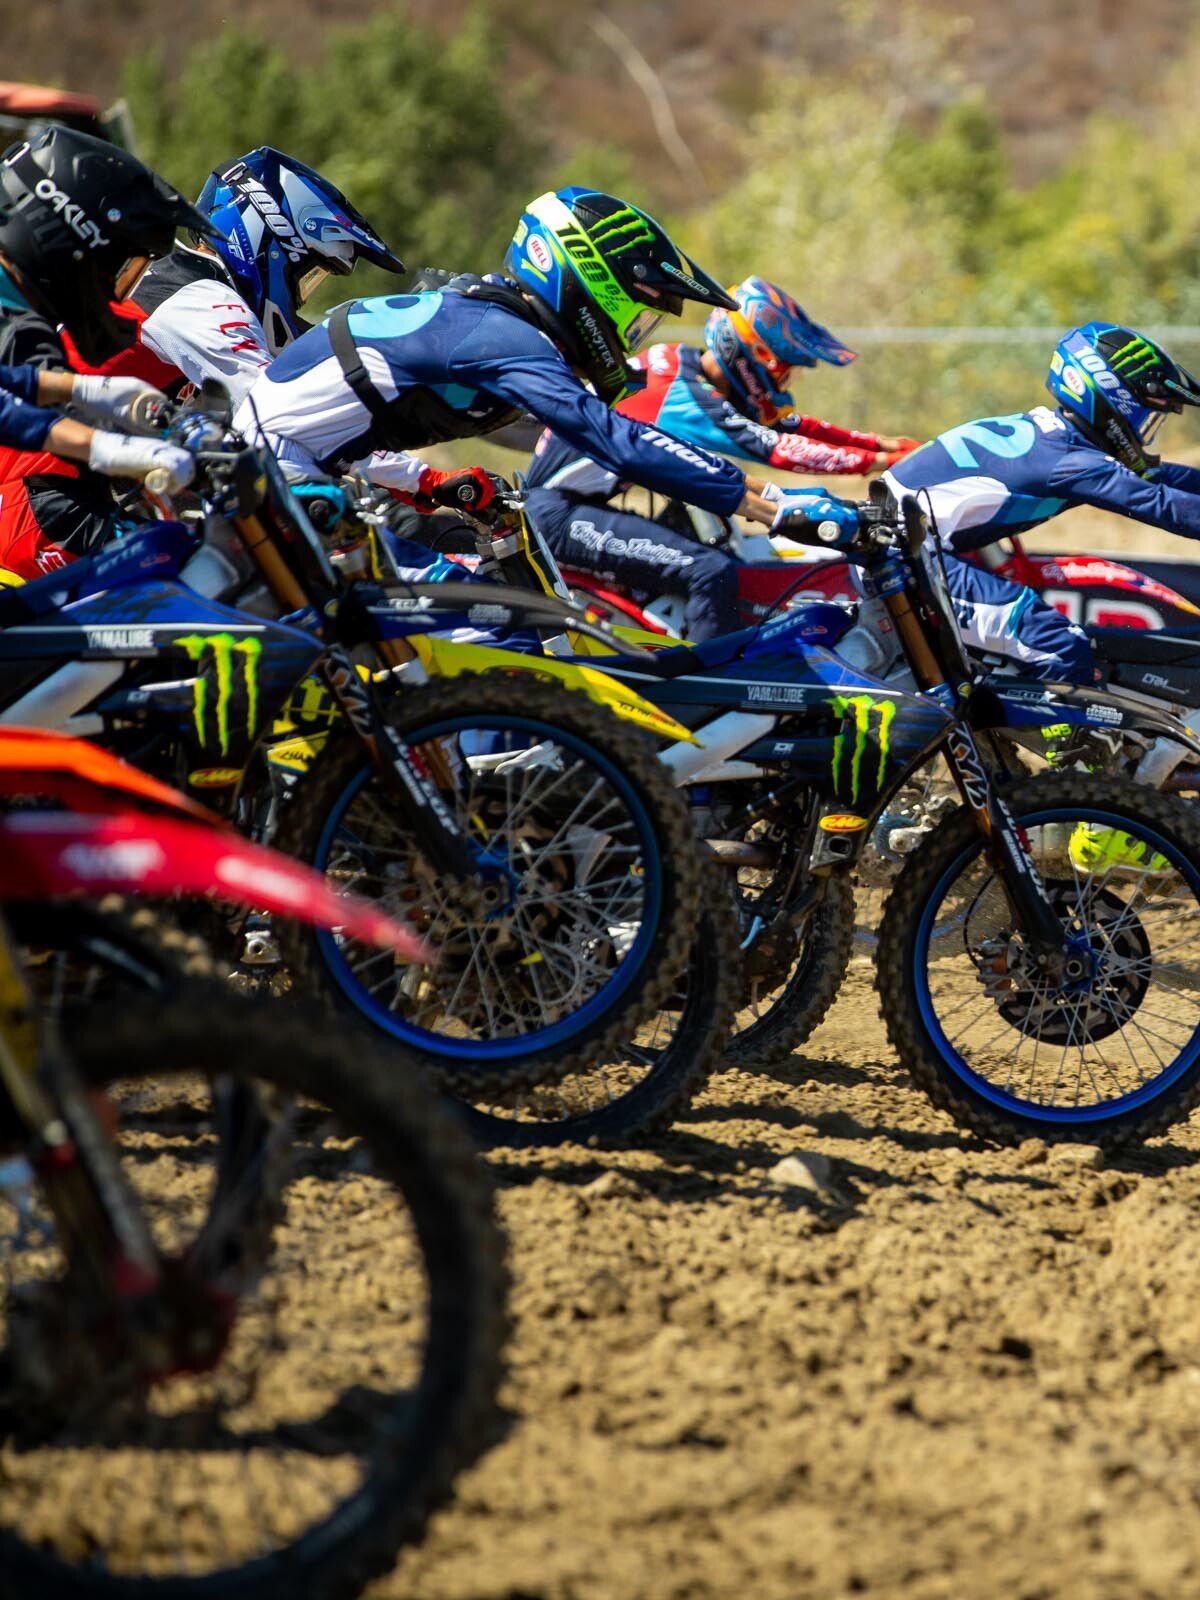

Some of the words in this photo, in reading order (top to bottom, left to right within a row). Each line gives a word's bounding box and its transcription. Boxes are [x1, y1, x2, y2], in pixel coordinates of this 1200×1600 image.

[35, 178, 110, 249] OAKLEY
[236, 177, 309, 263] 100%
[530, 239, 547, 267] BELL
